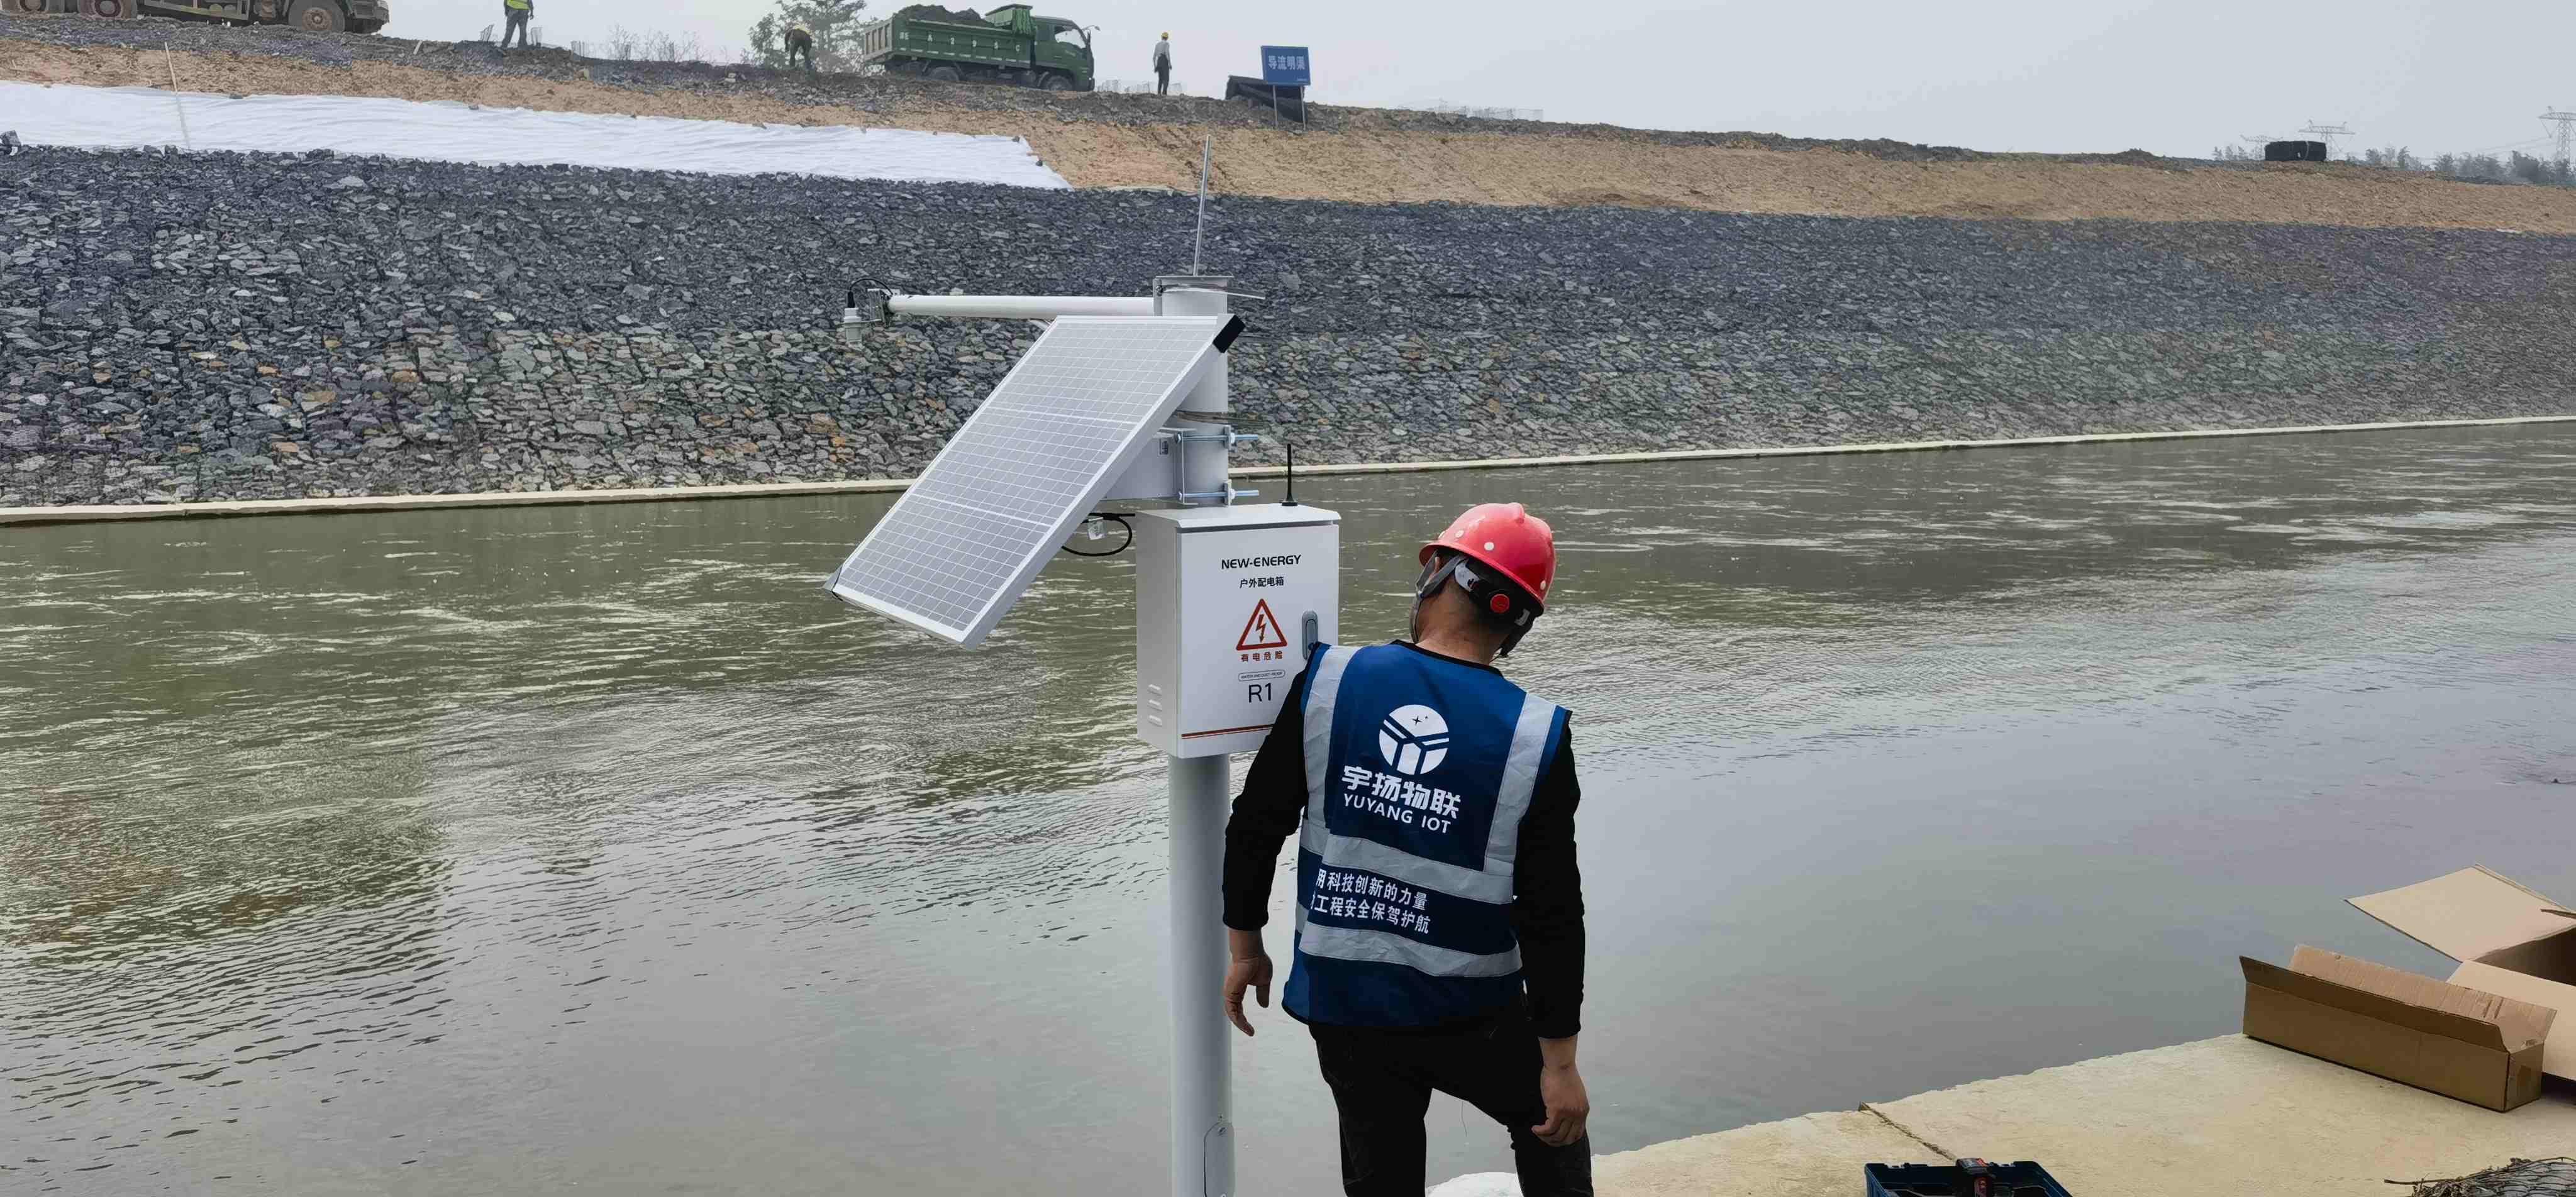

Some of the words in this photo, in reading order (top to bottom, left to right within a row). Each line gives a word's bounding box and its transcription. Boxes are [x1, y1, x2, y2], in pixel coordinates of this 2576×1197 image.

[1221, 554, 1301, 569] NEW-ENERGY
[1240, 576, 1284, 588] 户外配电箱
[1241, 651, 1282, 662] 有电危险
[1249, 683, 1271, 702] R1
[1341, 765, 1461, 819] 宇扬物联
[1344, 793, 1413, 824] YUYANG
[1421, 815, 1451, 834] IOT
[1316, 868, 1428, 910] 用科技创新的力量
[1311, 890, 1431, 934] 工程安全保驾护航
